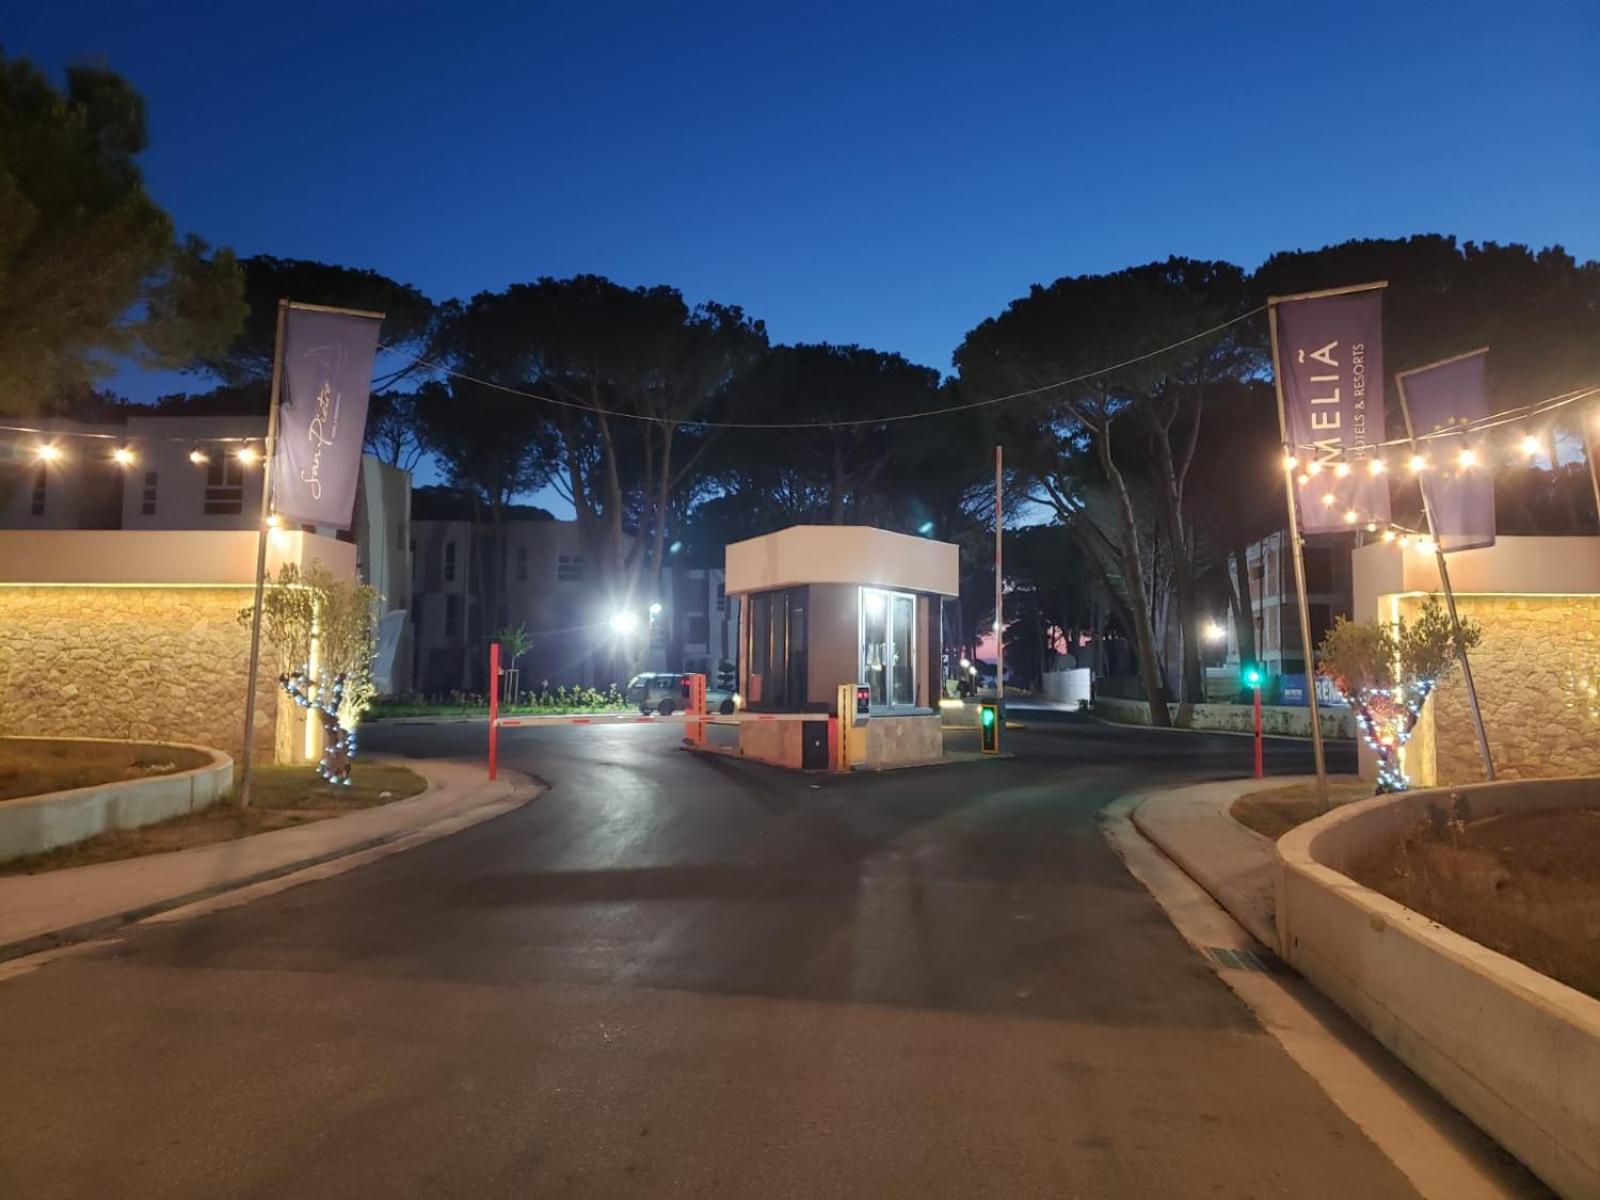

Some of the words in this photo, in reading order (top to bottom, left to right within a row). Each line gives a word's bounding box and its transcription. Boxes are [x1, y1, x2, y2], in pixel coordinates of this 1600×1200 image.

[1353, 343, 1365, 396] RESORTS
[1355, 400, 1365, 409] &
[1354, 413, 1366, 460] HOTELS
[301, 447, 321, 500] San
